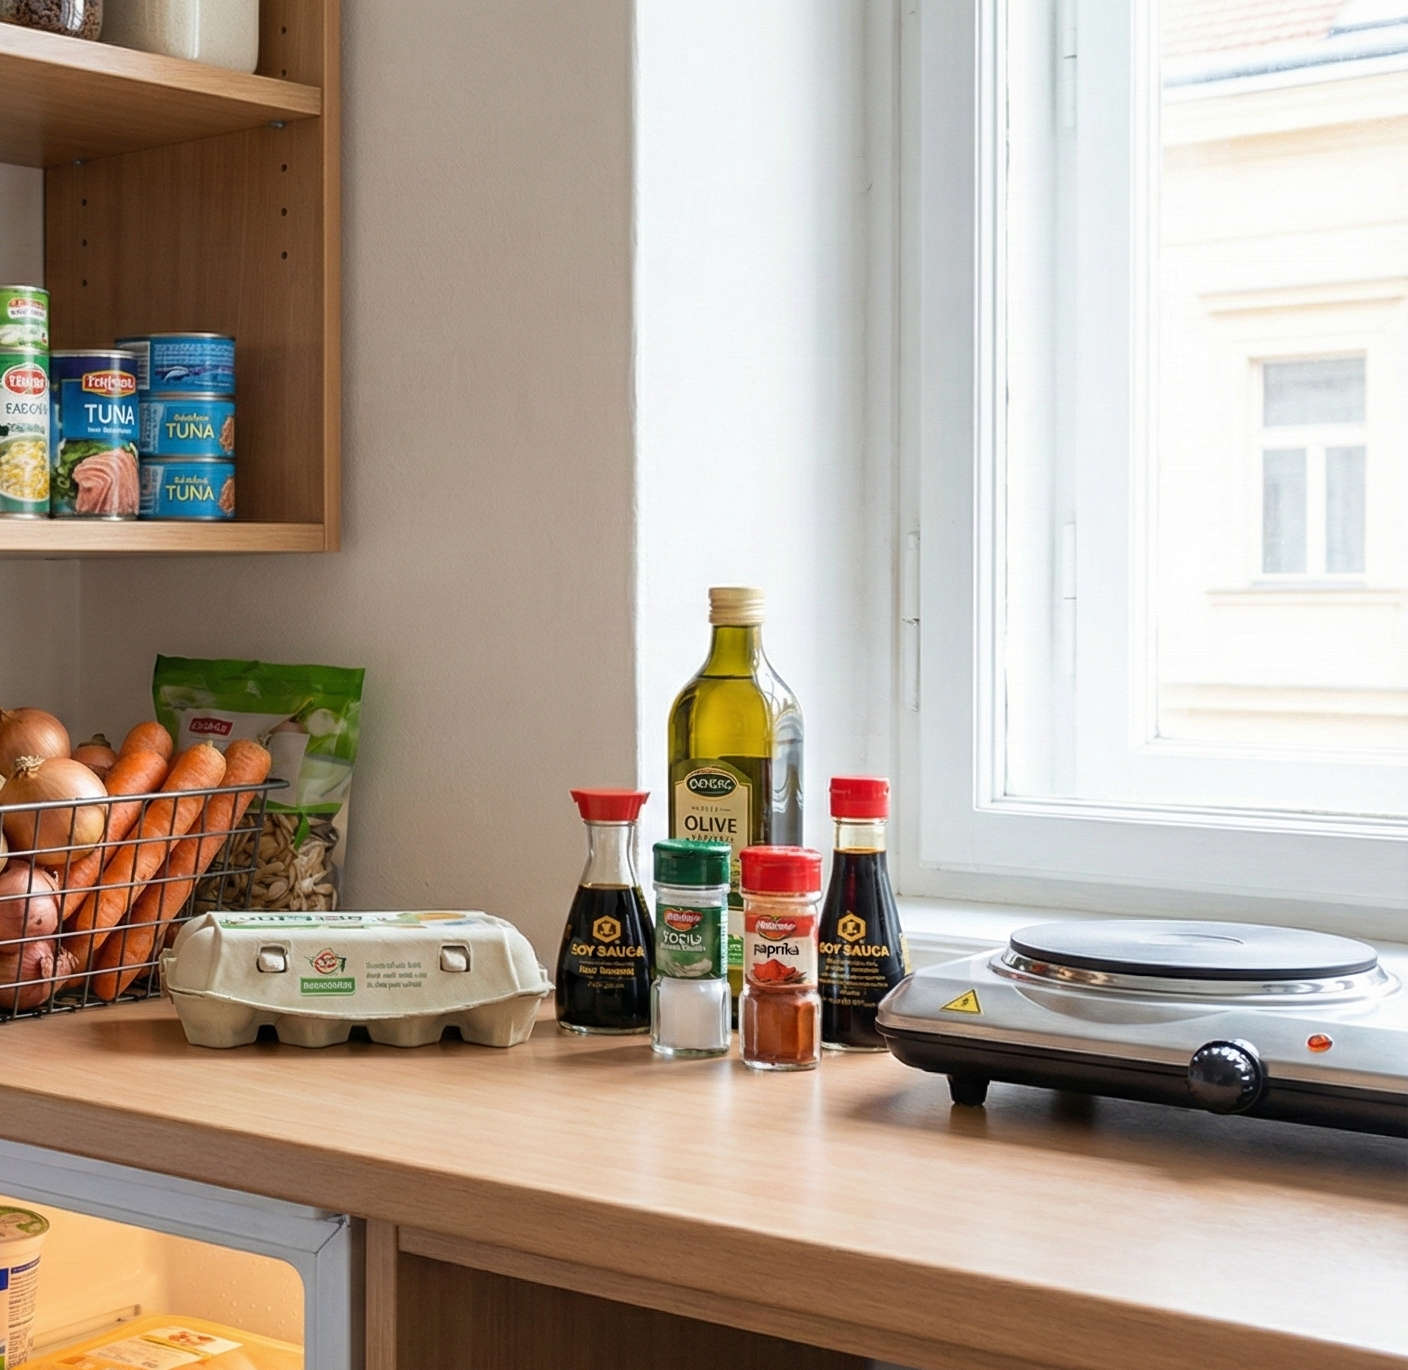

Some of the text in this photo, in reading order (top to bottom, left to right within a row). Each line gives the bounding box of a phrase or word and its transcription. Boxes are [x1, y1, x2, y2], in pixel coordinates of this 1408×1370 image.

[84, 404, 135, 425] TUNA
[166, 422, 215, 440] TUNA
[166, 485, 215, 502] TUNA
[684, 815, 737, 834] OLIVE
[571, 943, 596, 957] SOY
[753, 942, 799, 958] paprika
[819, 941, 890, 957] SOY SAUCA
